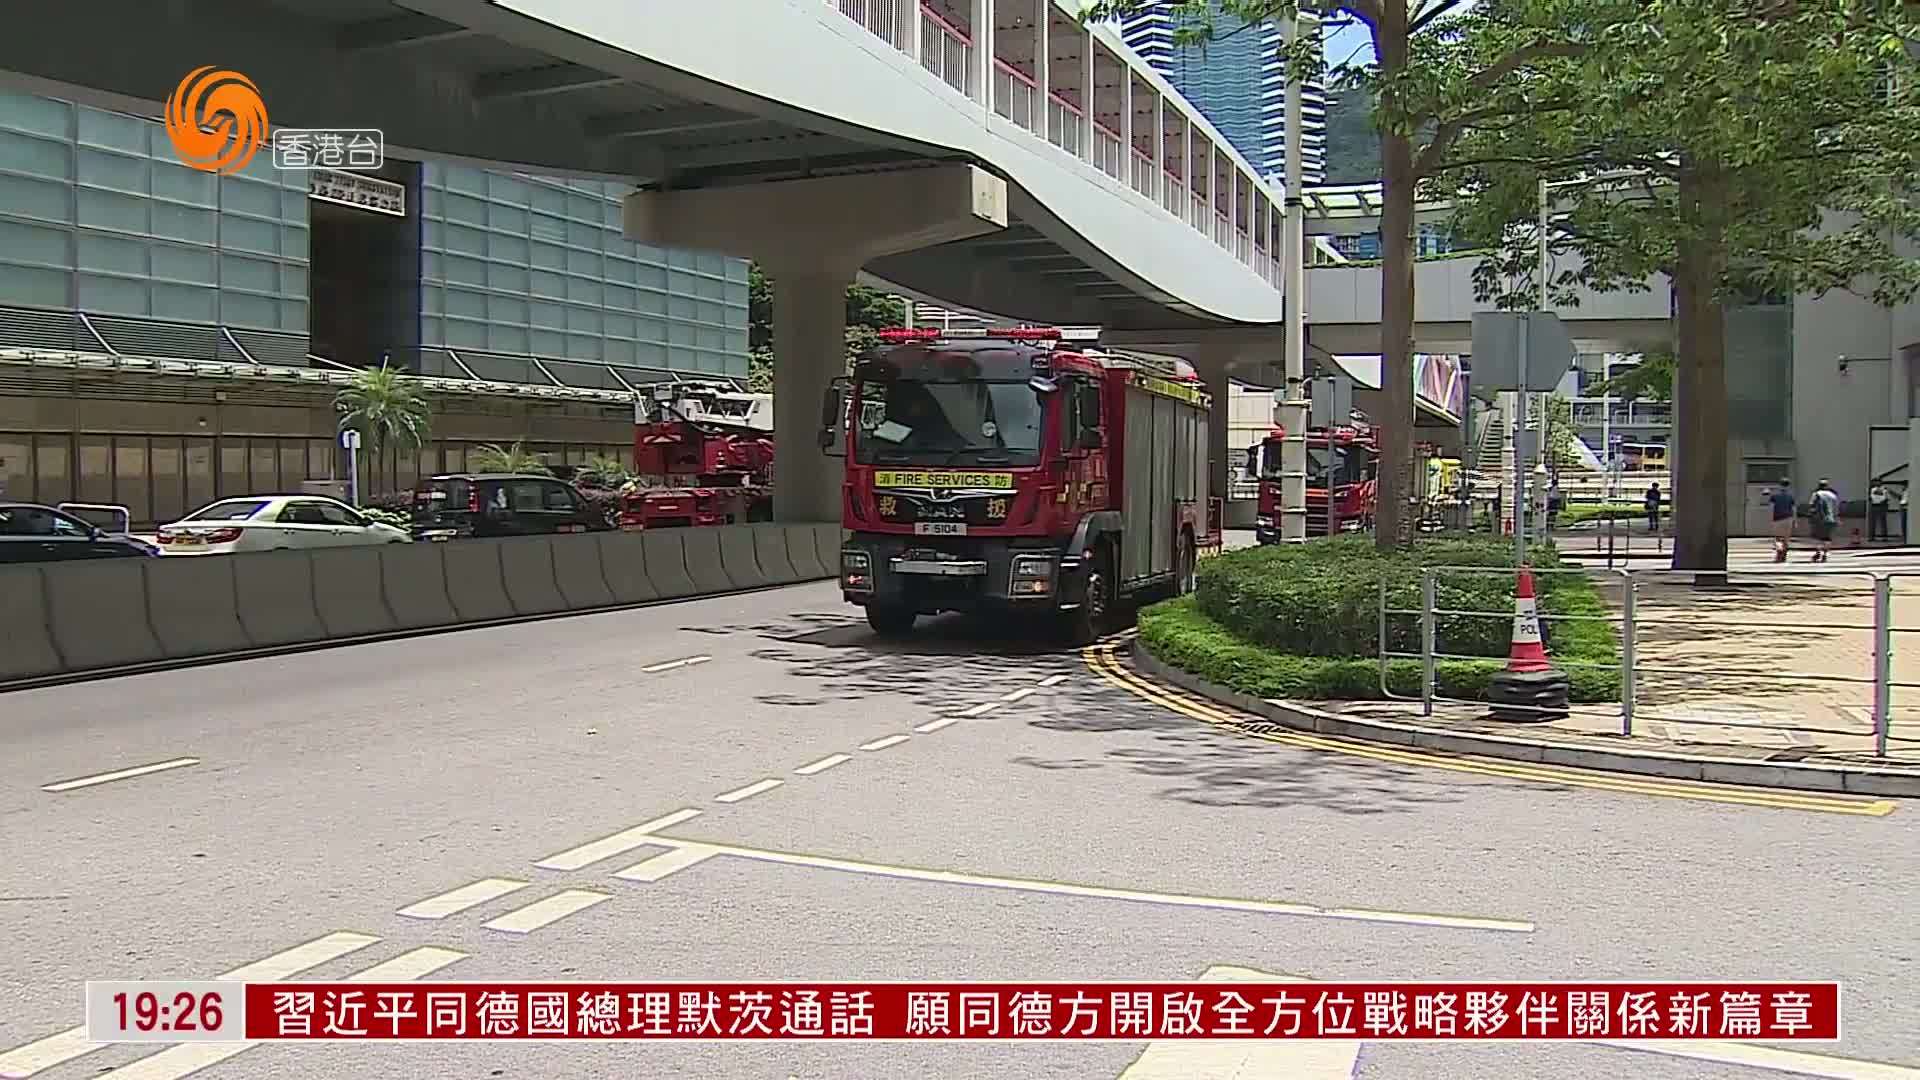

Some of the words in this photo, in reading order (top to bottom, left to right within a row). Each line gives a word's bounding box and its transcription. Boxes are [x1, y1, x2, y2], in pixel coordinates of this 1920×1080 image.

[895, 475, 922, 485] FIRE
[928, 475, 991, 486] SERVICES
[879, 496, 897, 516] 救
[922, 524, 929, 533] F
[935, 524, 957, 534] 5104
